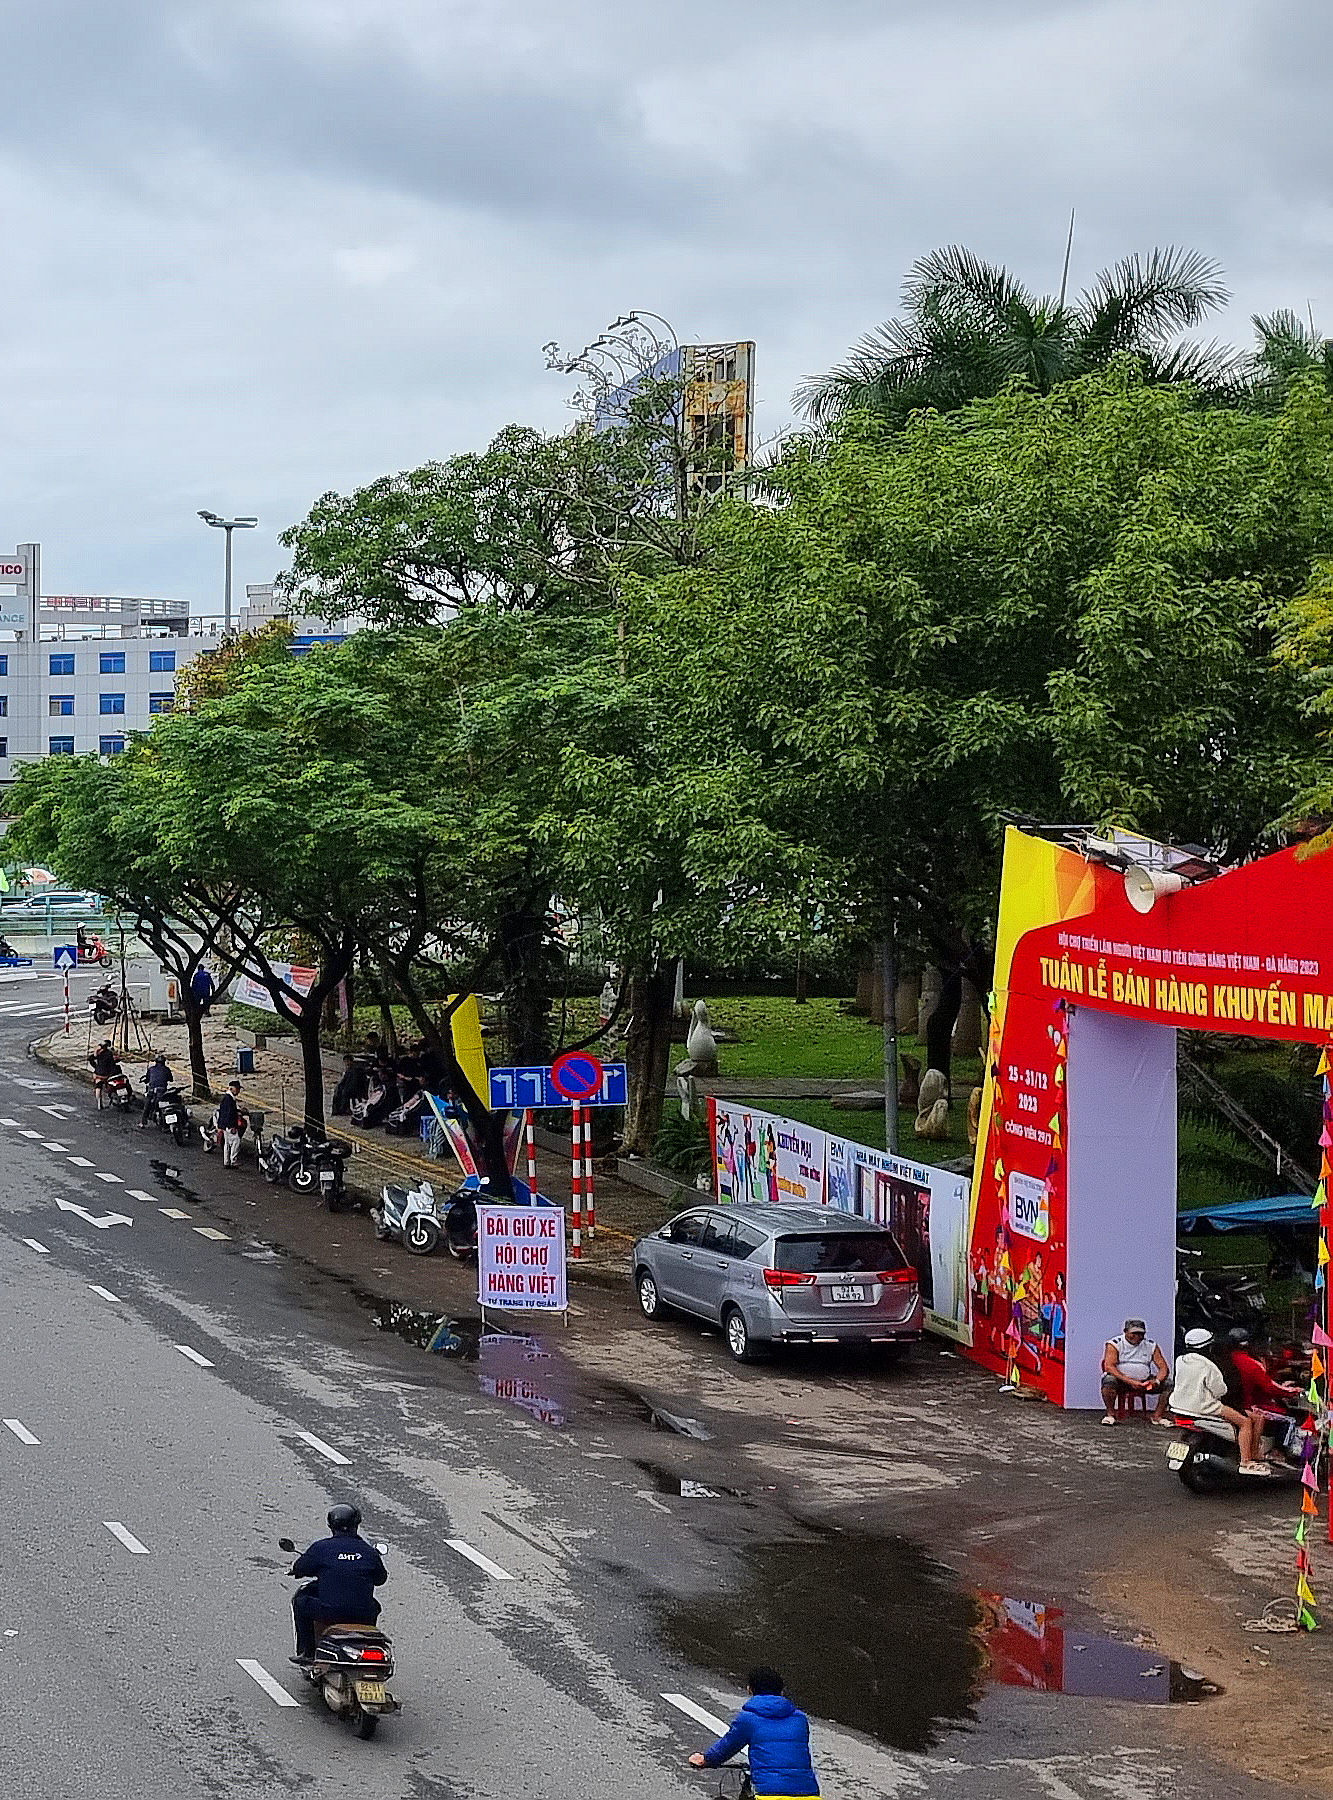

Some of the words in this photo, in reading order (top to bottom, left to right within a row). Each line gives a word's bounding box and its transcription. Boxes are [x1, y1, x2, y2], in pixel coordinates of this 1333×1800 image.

[1132, 942, 1146, 960] VIỆT
[1146, 946, 1162, 962] NAM
[1226, 951, 1241, 971] VIỆT
[1243, 954, 1260, 970] NAM
[1300, 959, 1319, 975] 2023
[1039, 951, 1084, 993] TUẦN
[1088, 957, 1108, 999] LỄ
[1112, 967, 1150, 1009] BÁN
[1155, 974, 1208, 1017] HÀNG
[1213, 979, 1297, 1027] KHUYẾN
[1008, 1064, 1018, 1082] 25
[1026, 1069, 1048, 1090] 31/12
[1018, 1093, 1038, 1114] 2023
[1005, 1119, 1023, 1137] CÔNG
[1015, 1194, 1039, 1223] BVN
[486, 1214, 509, 1236] BÃI
[512, 1215, 536, 1237] GIỮ
[539, 1219, 556, 1238] XE
[495, 1242, 517, 1269] HỘI
[521, 1244, 549, 1270] CHỢ
[488, 1270, 524, 1293] HÀNG
[528, 1272, 557, 1298] VIỆT
